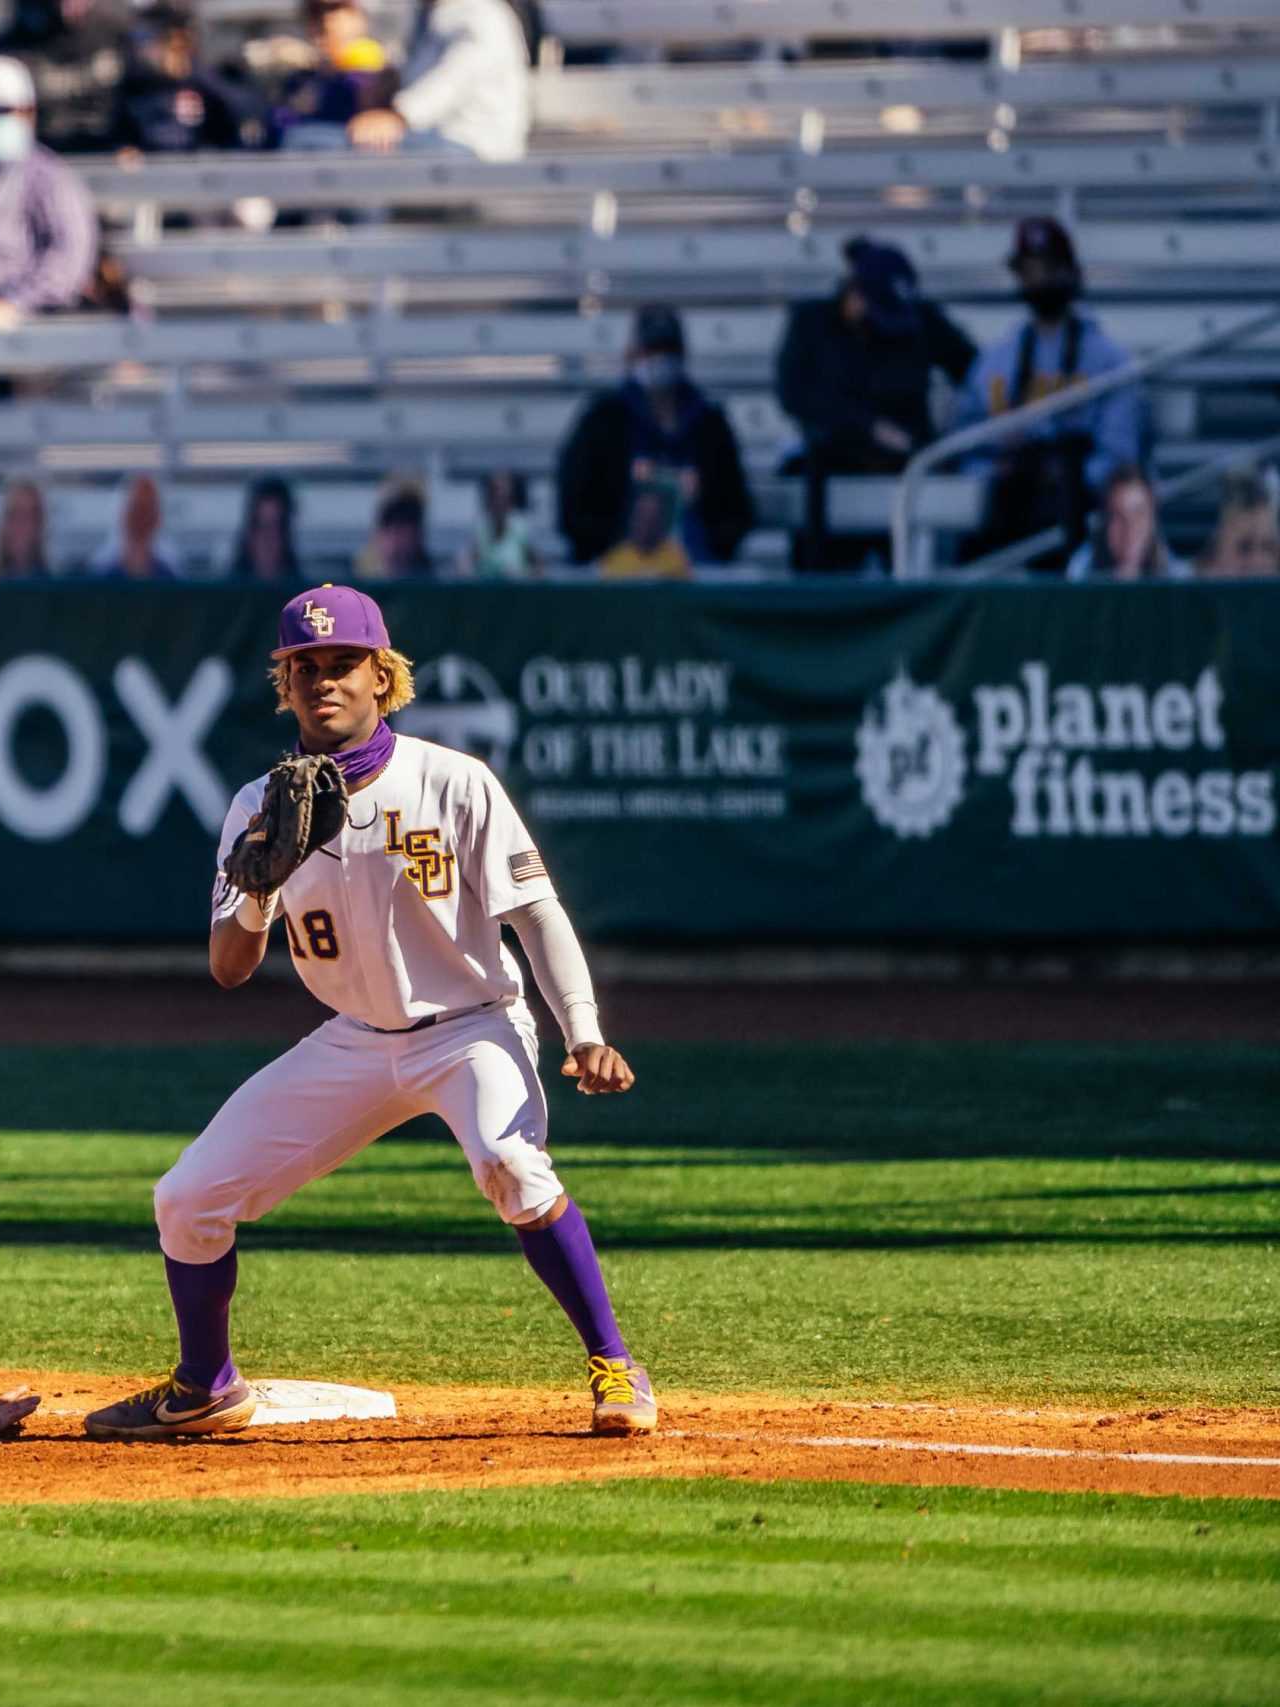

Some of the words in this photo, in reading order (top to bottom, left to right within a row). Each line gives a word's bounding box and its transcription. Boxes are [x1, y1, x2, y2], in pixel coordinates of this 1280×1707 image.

[303, 600, 335, 637] LSU
[521, 656, 615, 714] OUR
[622, 656, 733, 714] LADY
[590, 725, 665, 778] THE
[677, 717, 787, 778] LAKE
[973, 661, 1225, 775] planet
[1011, 748, 1275, 837] fitness
[384, 809, 455, 900] LSU
[284, 909, 340, 960] 18
